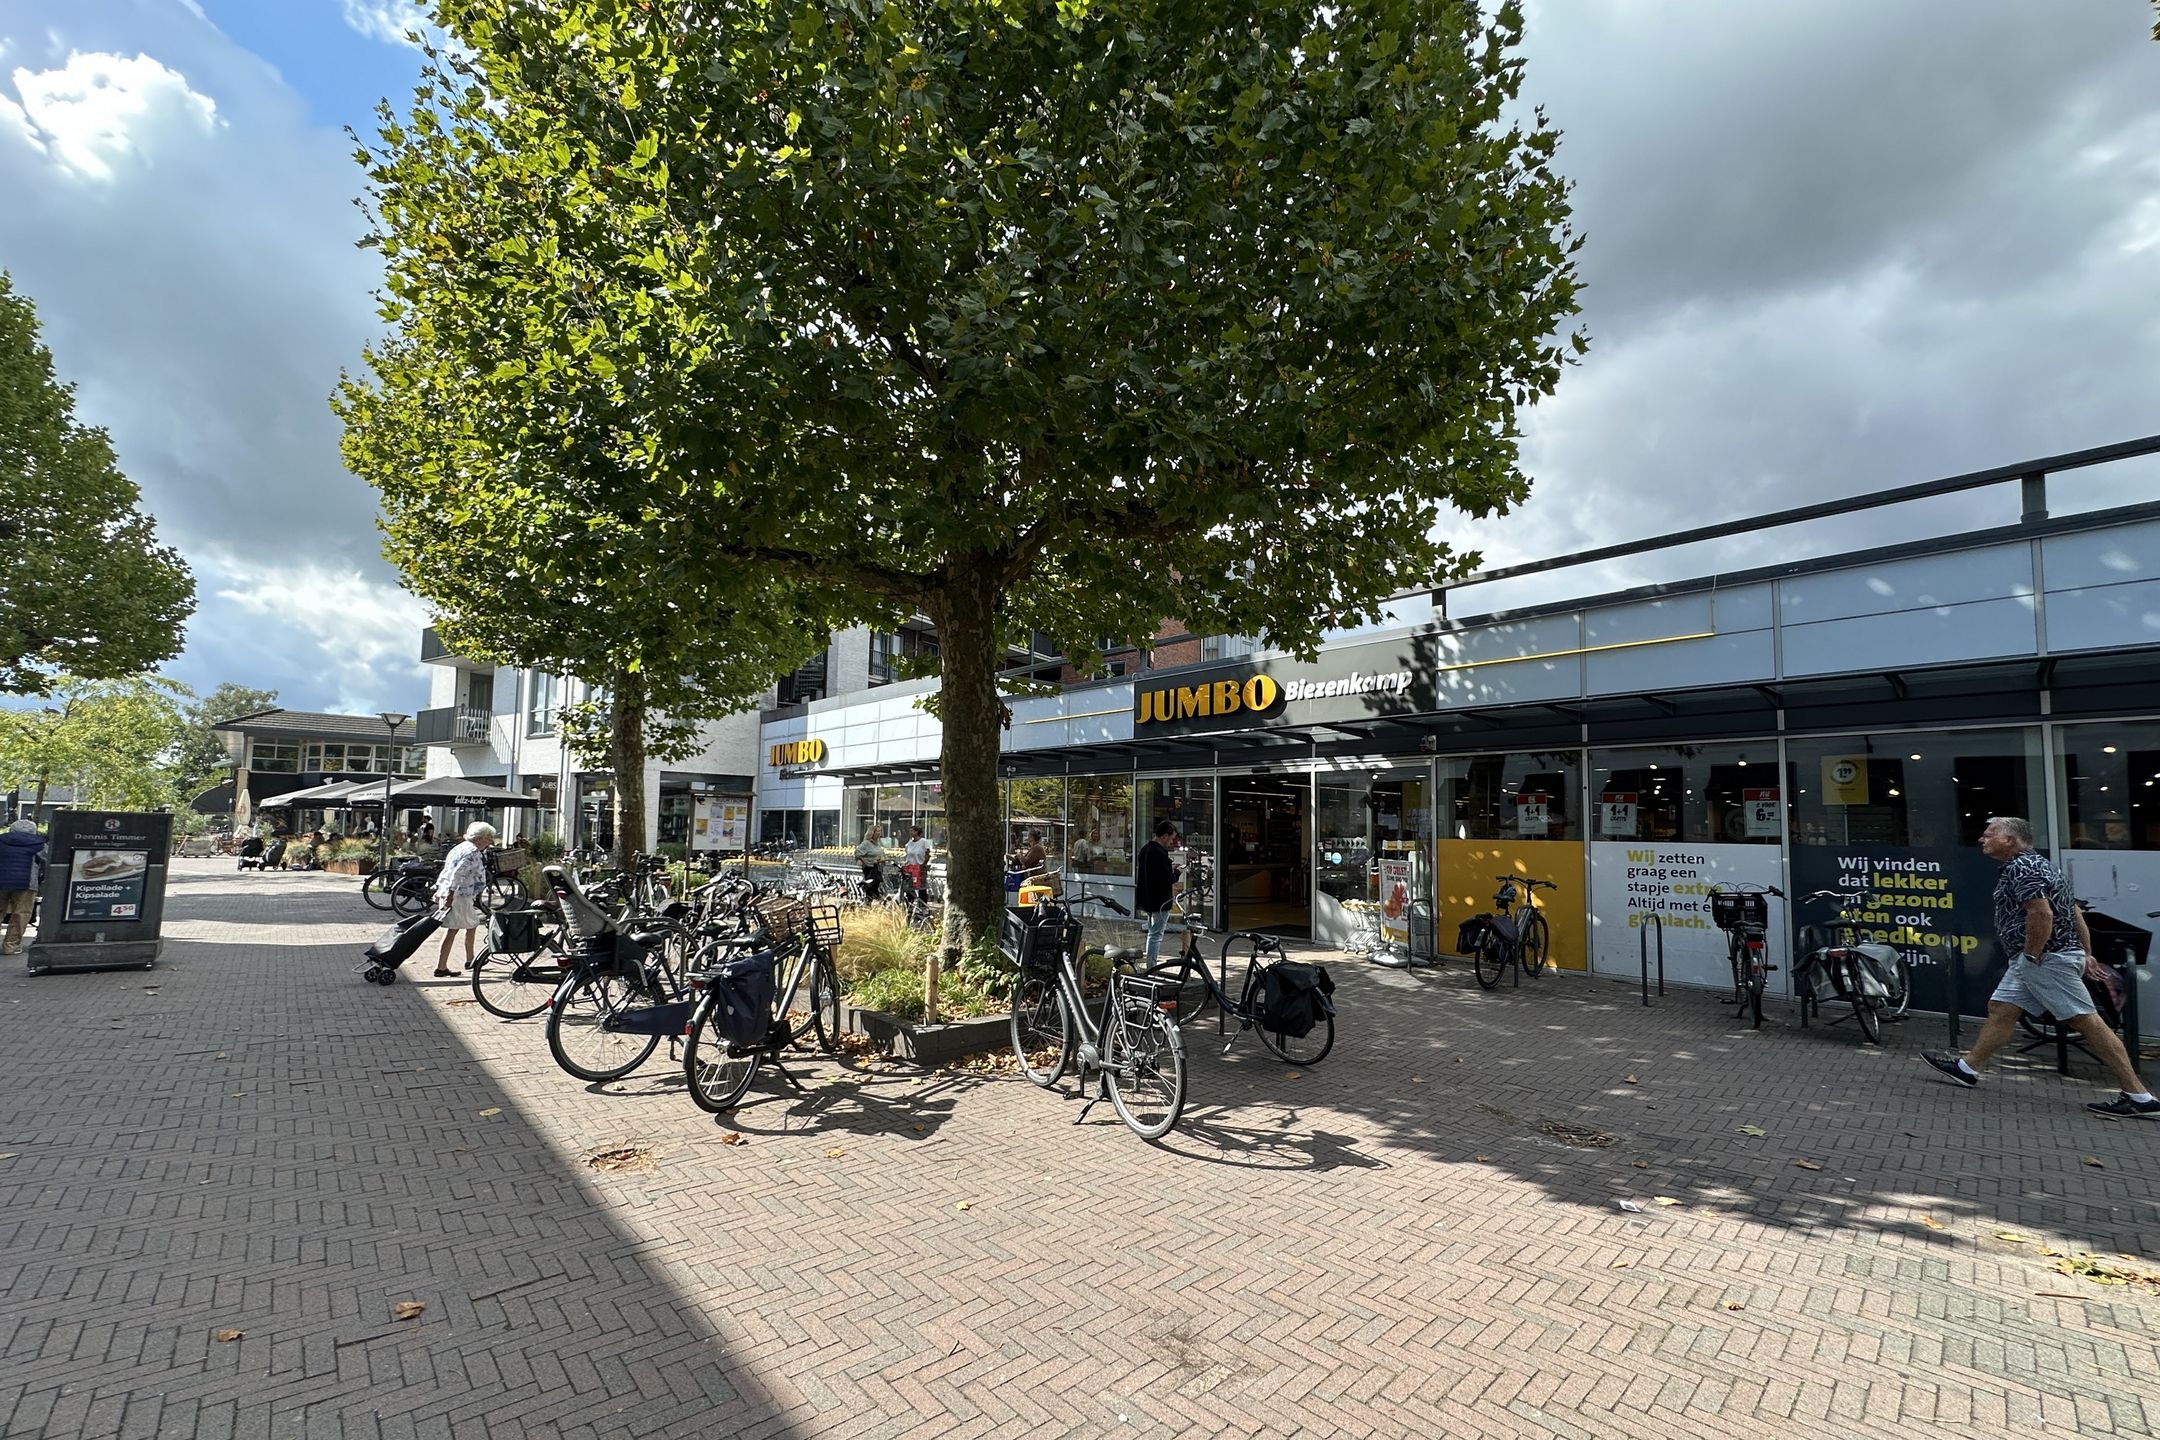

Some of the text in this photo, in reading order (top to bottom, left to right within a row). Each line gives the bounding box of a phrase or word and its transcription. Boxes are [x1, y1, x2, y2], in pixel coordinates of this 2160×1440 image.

[1136, 671, 1412, 724] JUMBO Biezenkamp
[768, 738, 823, 767] JUMBO
[110, 833, 147, 841] Timmer
[1627, 850, 1705, 866] Wij zetten
[1838, 856, 1941, 873] Wij vinden
[1627, 867, 1697, 880] graag een
[1838, 872, 1948, 890] dat lekker
[76, 884, 123, 892] Kiprollade
[1627, 881, 1670, 896] stapje
[1627, 897, 1665, 912] Altijd
[1669, 900, 1699, 911] met
[1866, 893, 1953, 909] gezond
[1895, 912, 1932, 926] ook
